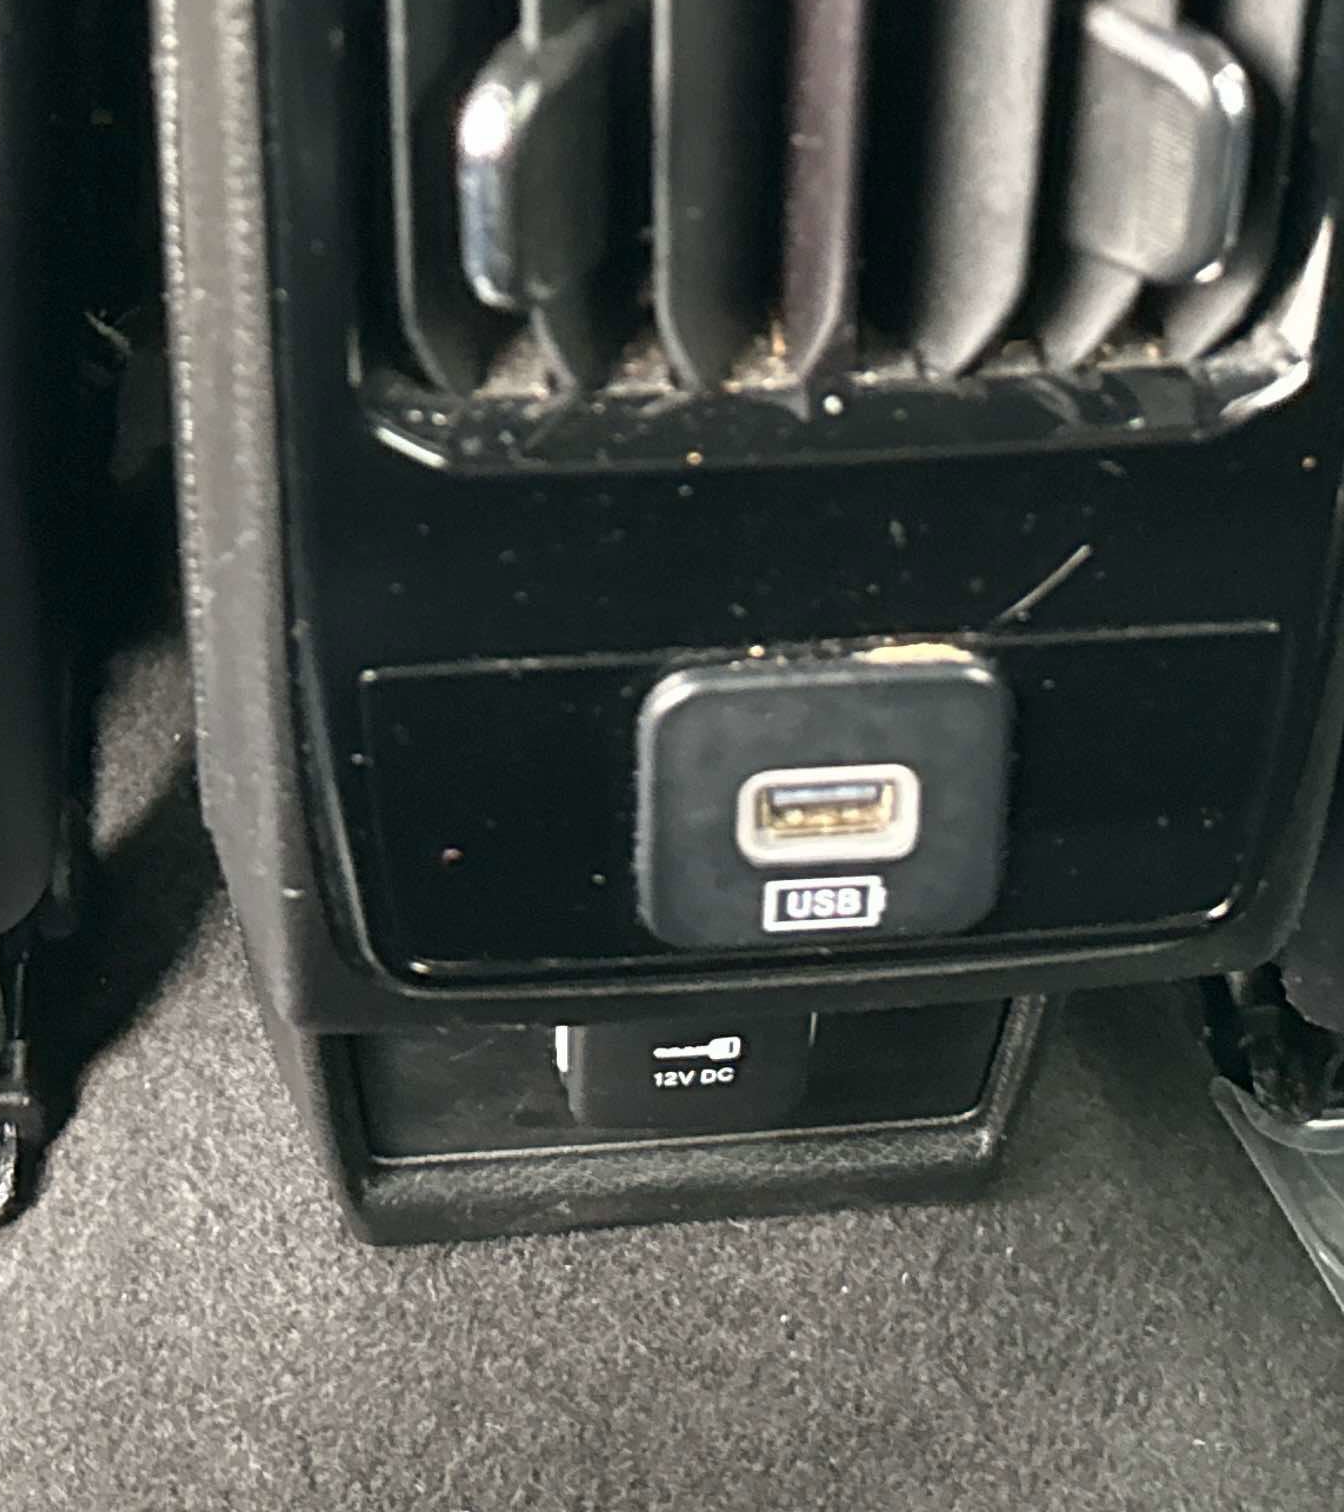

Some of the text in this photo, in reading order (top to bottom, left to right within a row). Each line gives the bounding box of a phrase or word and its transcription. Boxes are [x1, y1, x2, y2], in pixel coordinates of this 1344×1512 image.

[786, 888, 862, 918] USB
[654, 1067, 735, 1087] 12V DC
